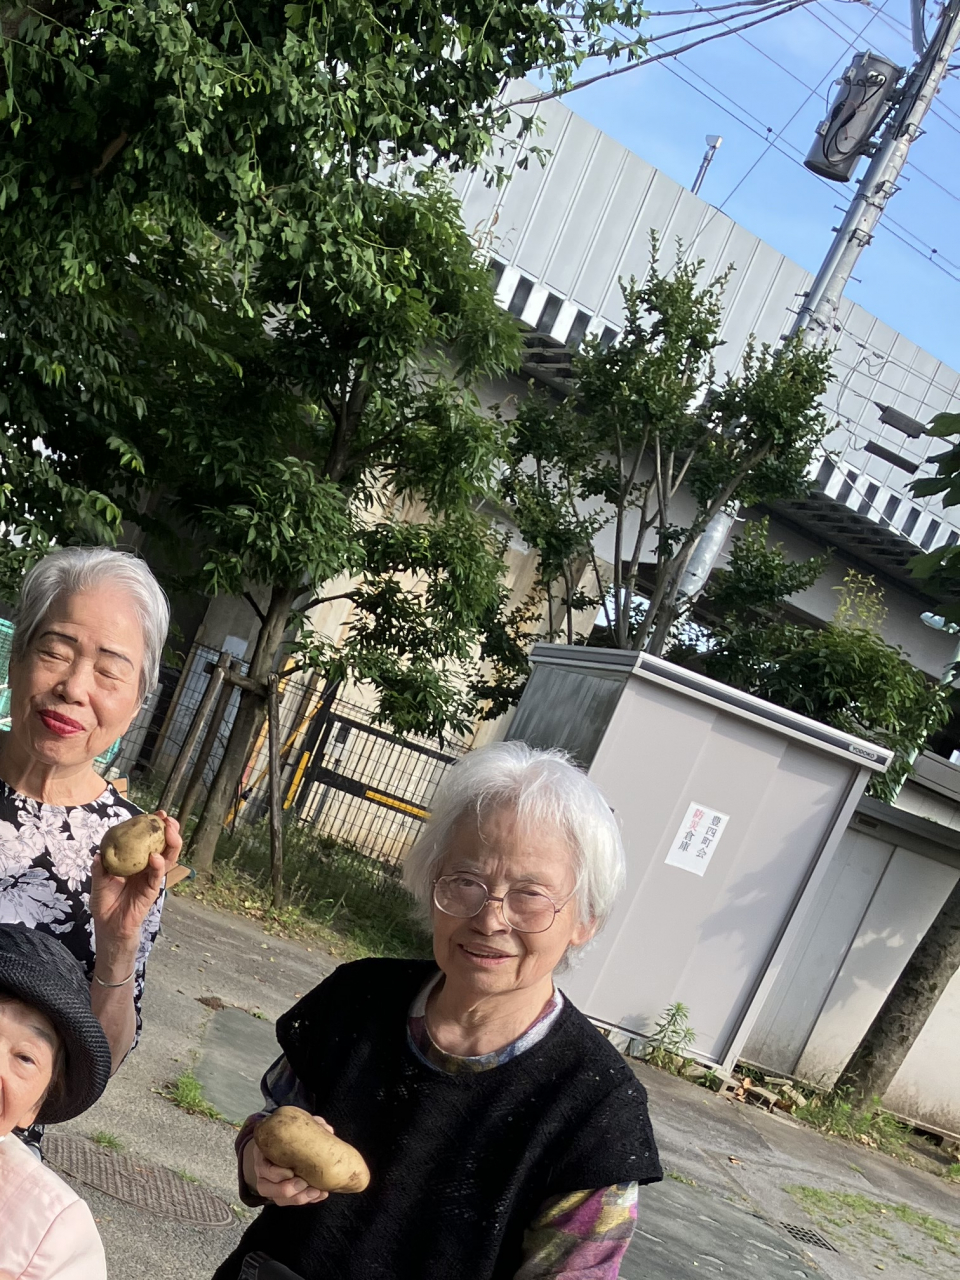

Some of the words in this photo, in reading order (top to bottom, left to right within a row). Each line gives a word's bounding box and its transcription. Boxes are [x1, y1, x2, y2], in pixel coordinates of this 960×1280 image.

[677, 808, 705, 853] 防災倉庫
[695, 815, 722, 859] 豊四町会
